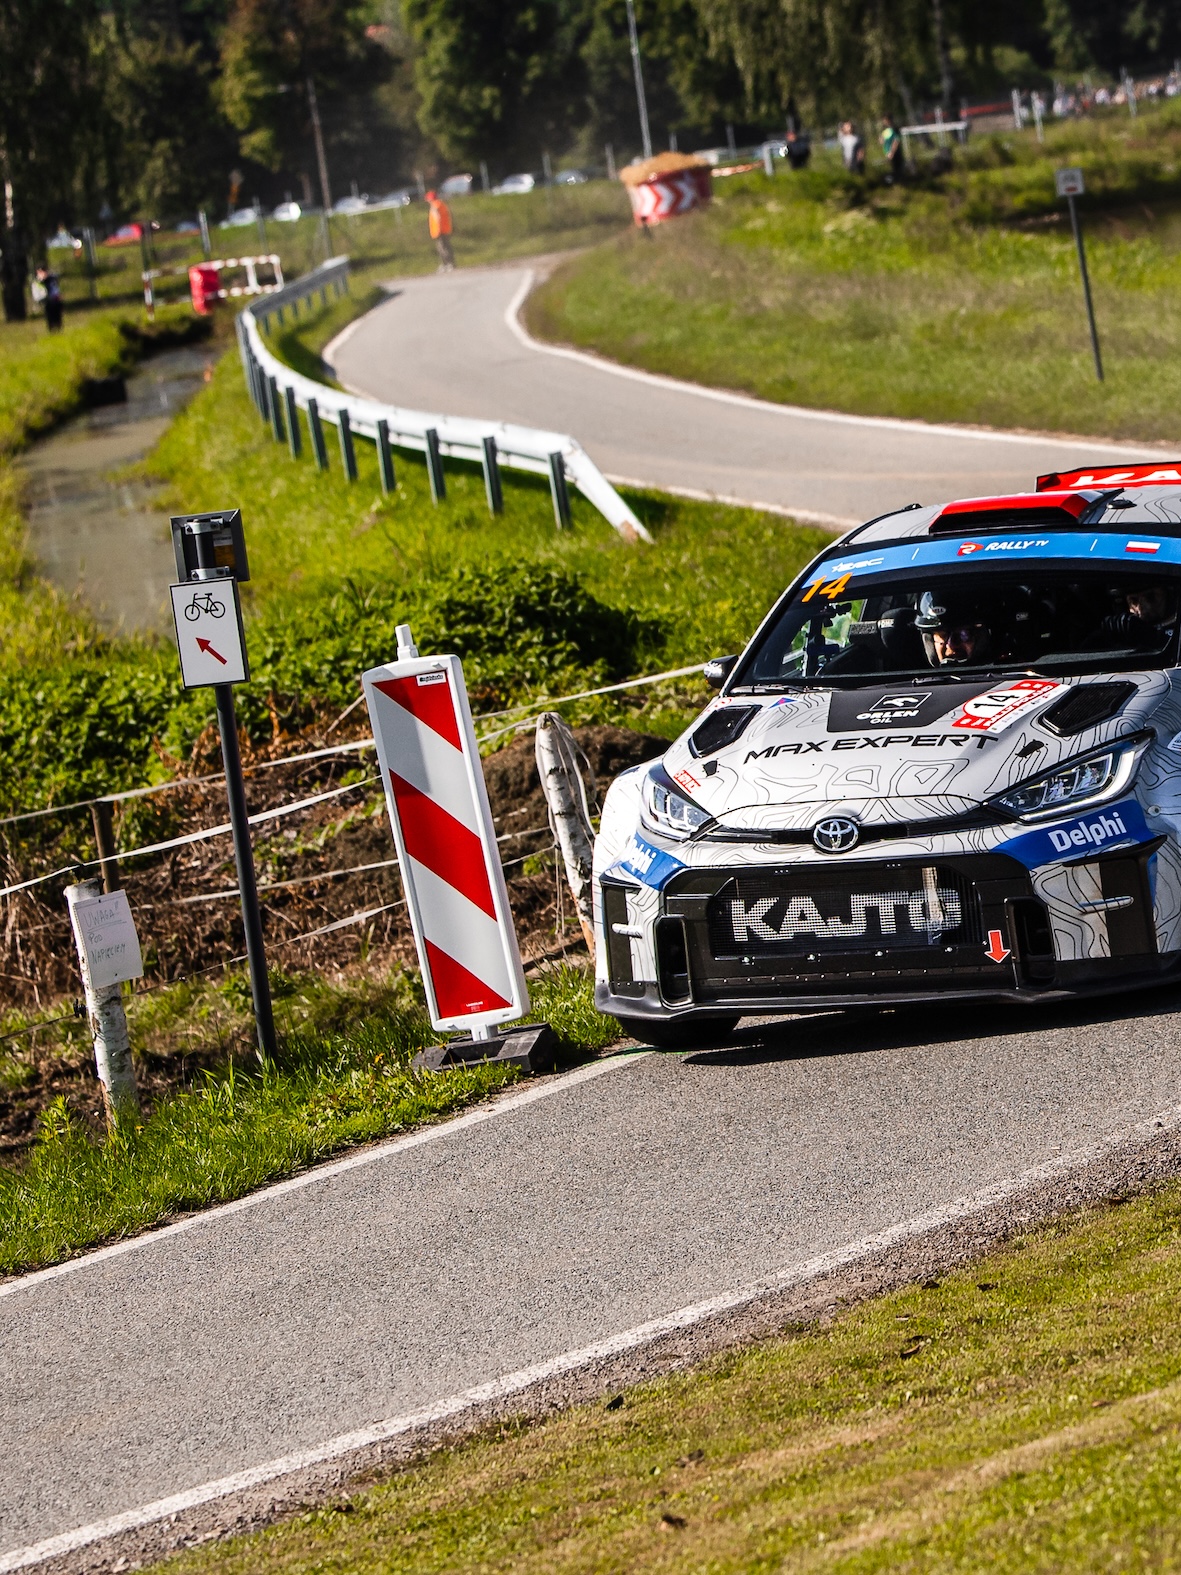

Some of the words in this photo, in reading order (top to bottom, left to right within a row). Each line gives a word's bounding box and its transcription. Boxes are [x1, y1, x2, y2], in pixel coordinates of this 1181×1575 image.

[985, 541, 1034, 551] RALLY
[802, 572, 853, 602] 14
[857, 710, 919, 720] ORLEN
[973, 695, 1020, 709] 14
[743, 741, 832, 764] MAX
[831, 735, 998, 751] EXPERT
[1048, 812, 1127, 852] Delphi
[731, 888, 962, 942] KAJTO
